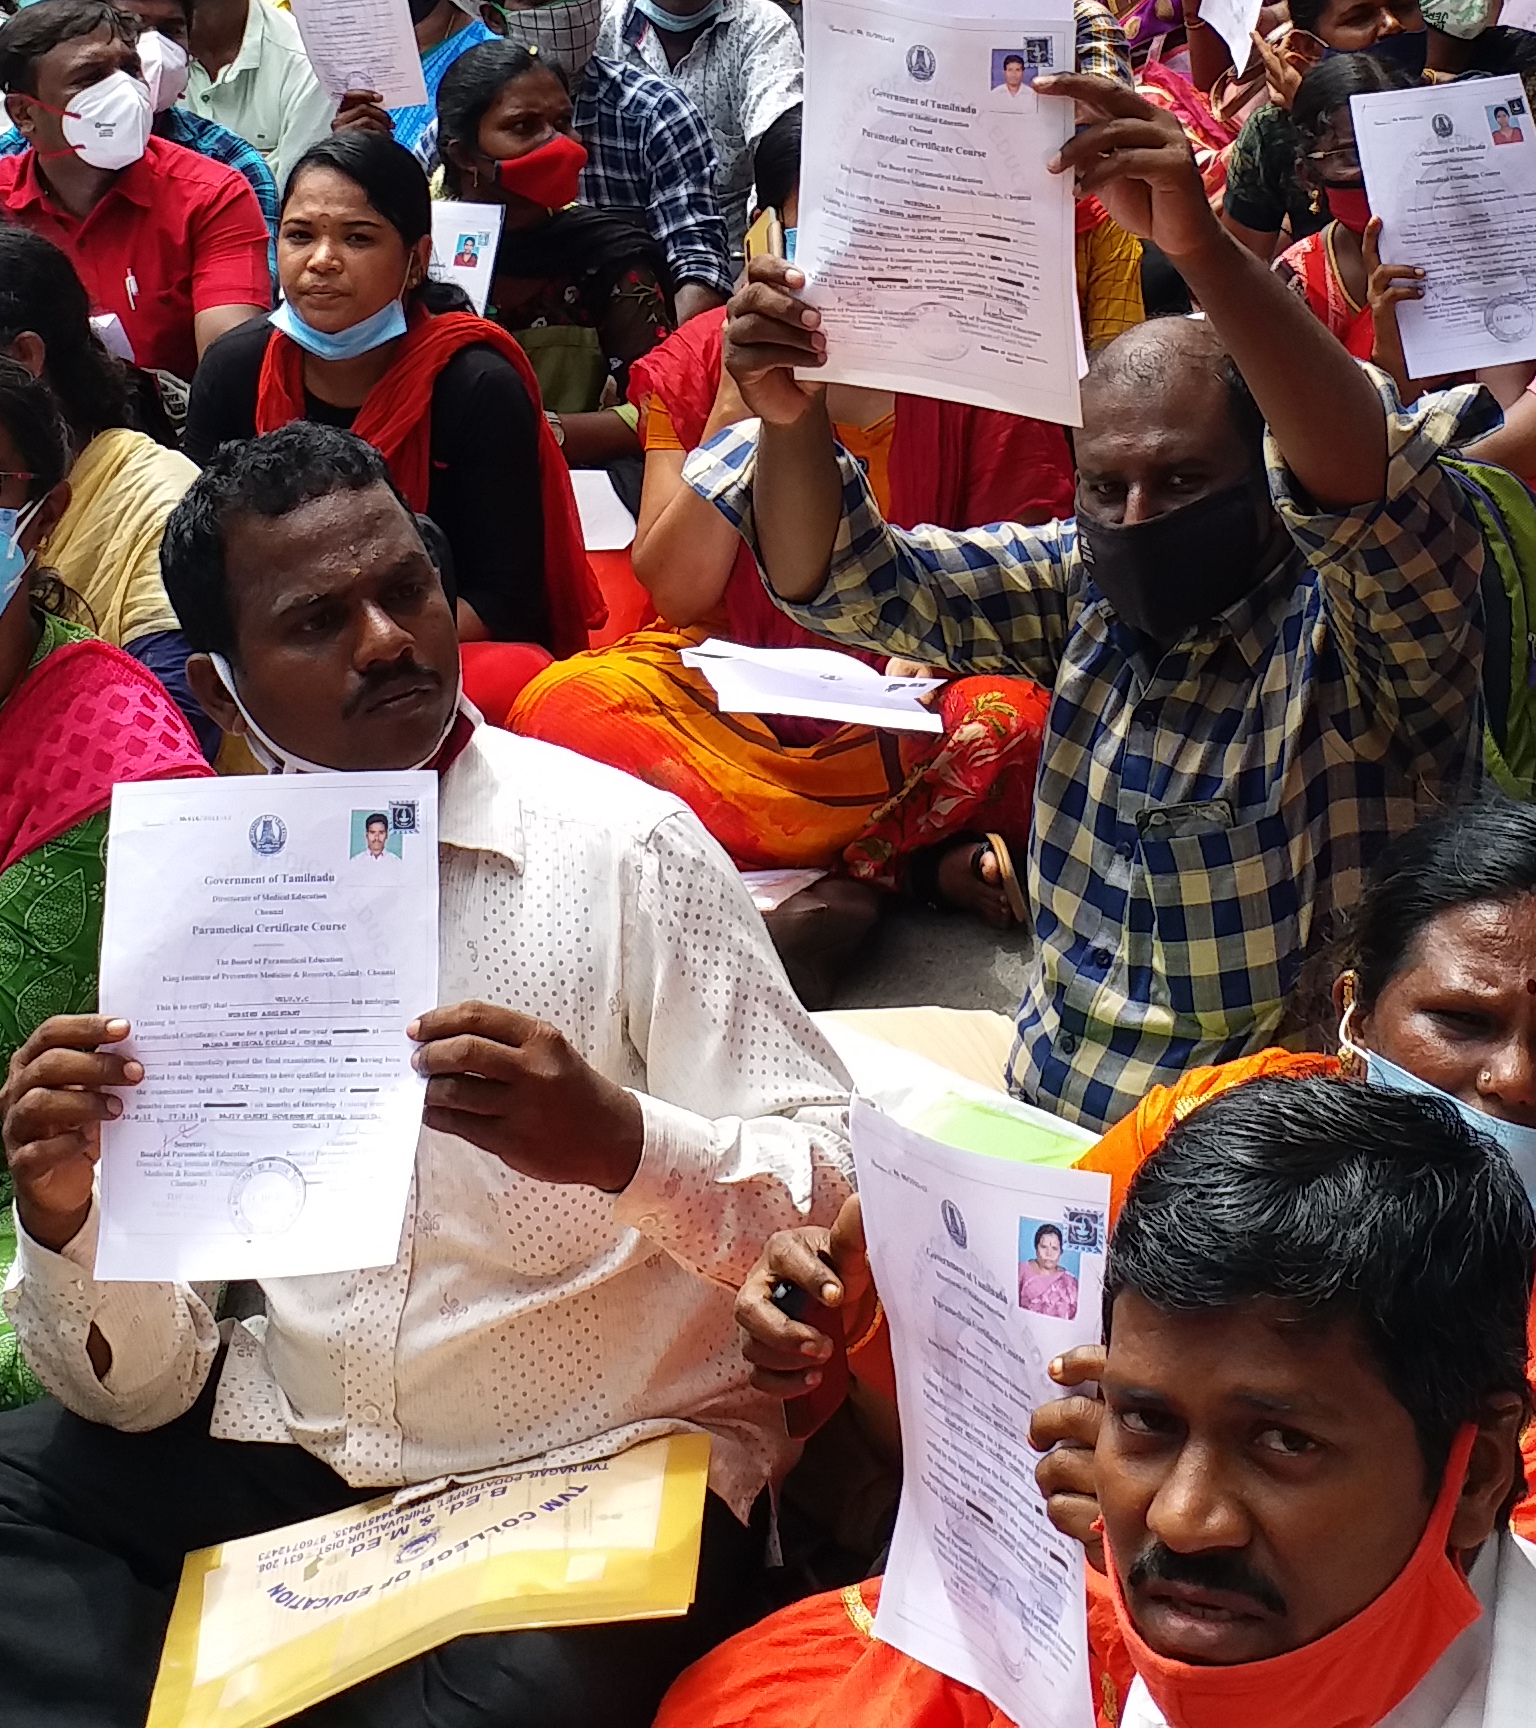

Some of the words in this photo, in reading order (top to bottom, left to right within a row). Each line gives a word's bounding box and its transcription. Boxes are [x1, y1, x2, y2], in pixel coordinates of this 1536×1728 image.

[861, 127, 908, 146] Paramedical
[909, 137, 953, 154] Certificate
[955, 145, 986, 159] Course
[204, 873, 266, 887] Government
[268, 873, 278, 883] of
[281, 871, 335, 884] Tamilnadu
[192, 922, 254, 936] Paramedical
[255, 921, 309, 934] Certificate
[311, 920, 347, 931] Course
[580, 1462, 609, 1472] TVM
[443, 1485, 508, 1512] B.Ed.
[540, 1483, 588, 1513] TVM
[347, 1505, 432, 1543] THIRUVALLUR
[419, 1514, 435, 1527] &
[347, 1524, 410, 1558] M.Ed.
[419, 1511, 537, 1572] COLLEGE
[283, 1552, 304, 1563] 631
[378, 1569, 411, 1588] OF
[267, 1582, 374, 1611] EDUCATION
